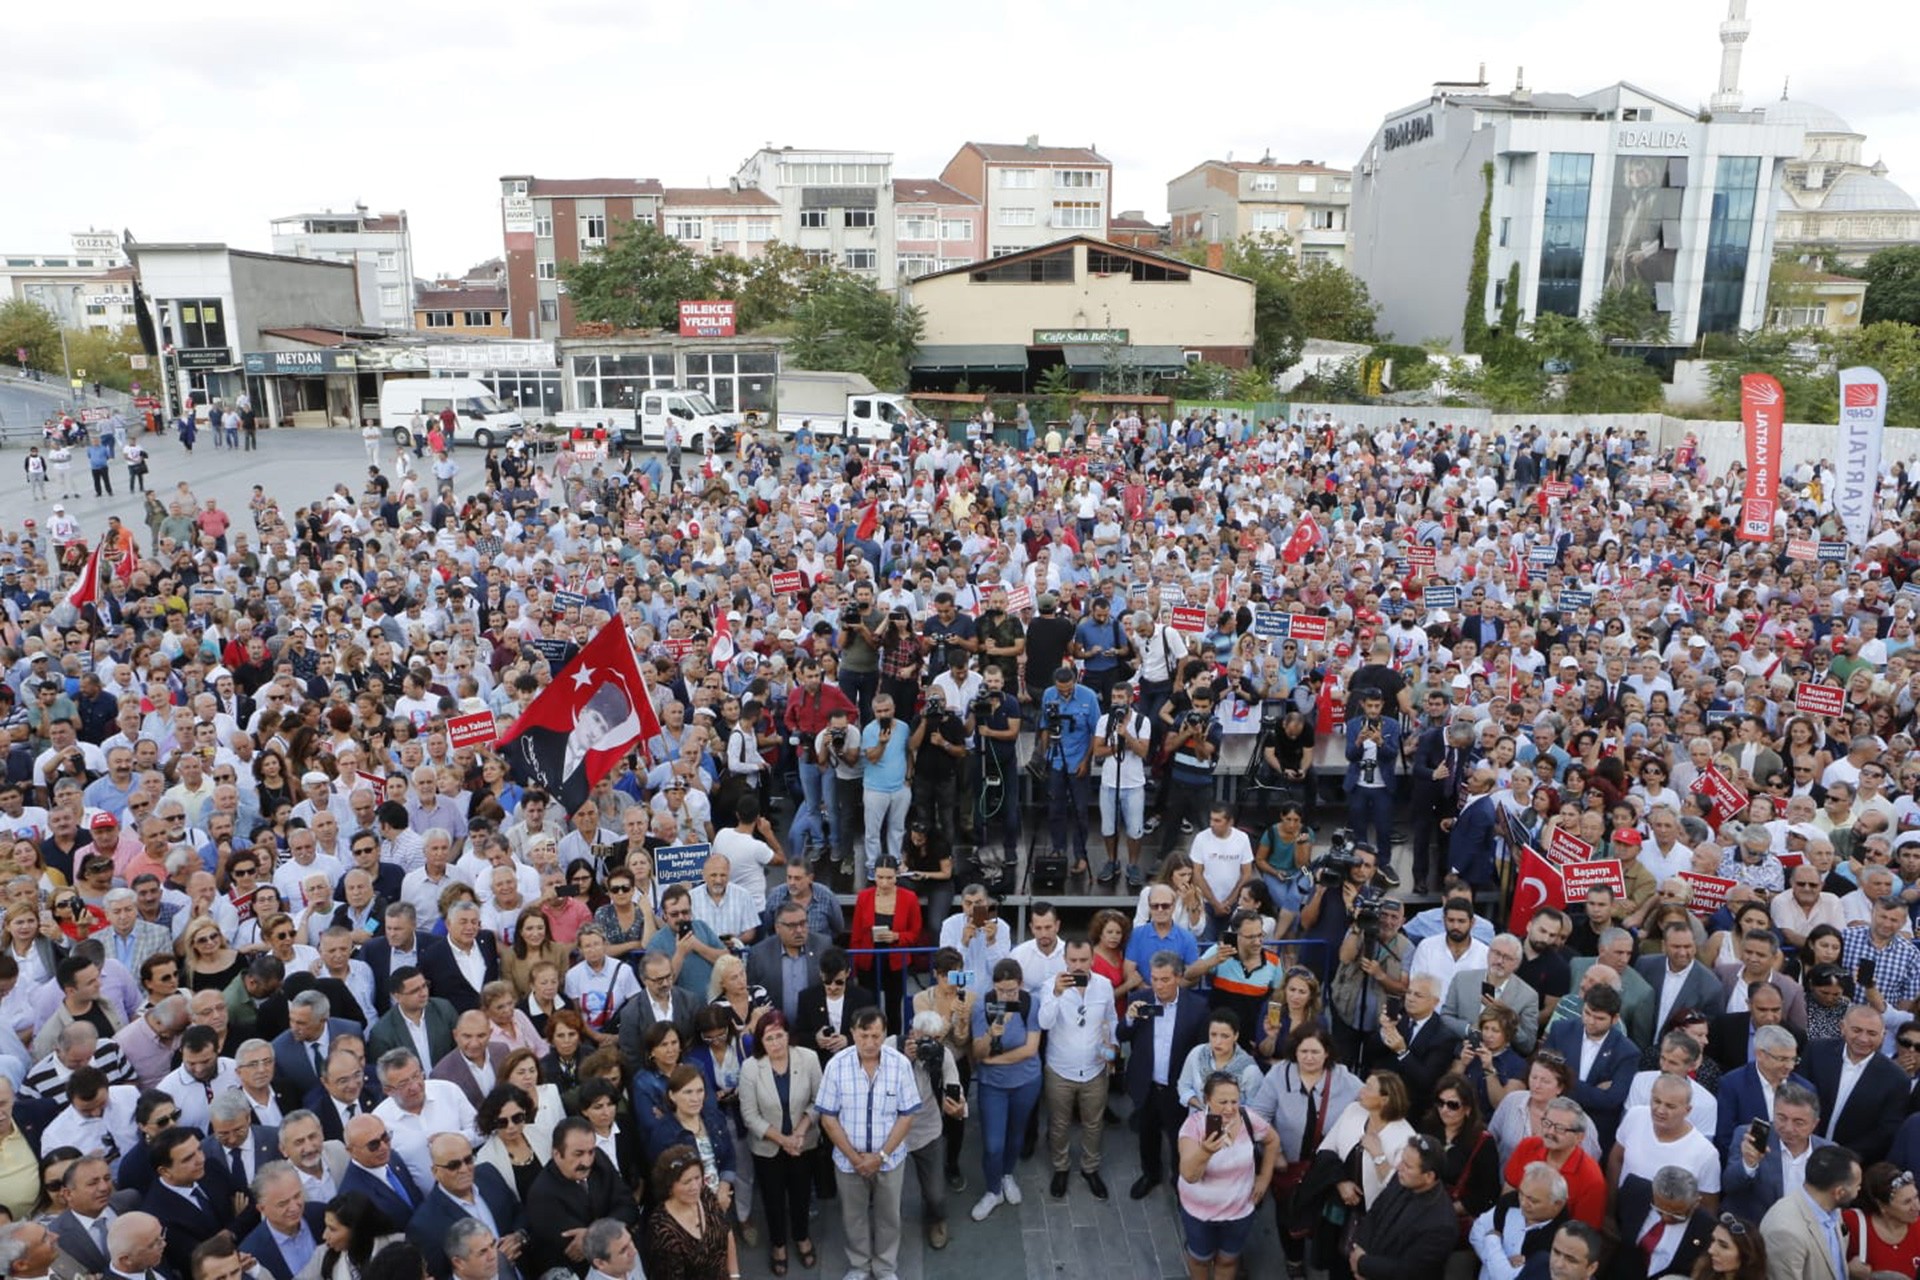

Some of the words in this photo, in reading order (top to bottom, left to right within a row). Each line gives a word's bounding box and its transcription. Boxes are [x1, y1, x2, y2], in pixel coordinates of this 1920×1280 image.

[1388, 113, 1434, 151] DALIDA
[1625, 130, 1689, 149] DALIDA
[682, 303, 733, 316] DİLEKÇE
[276, 352, 322, 364] MEYDAN
[451, 724, 468, 736] Asla
[467, 720, 492, 731] Yalnız
[1573, 867, 1611, 878] Başarıyı
[1566, 875, 1620, 886] Cezalandırmak
